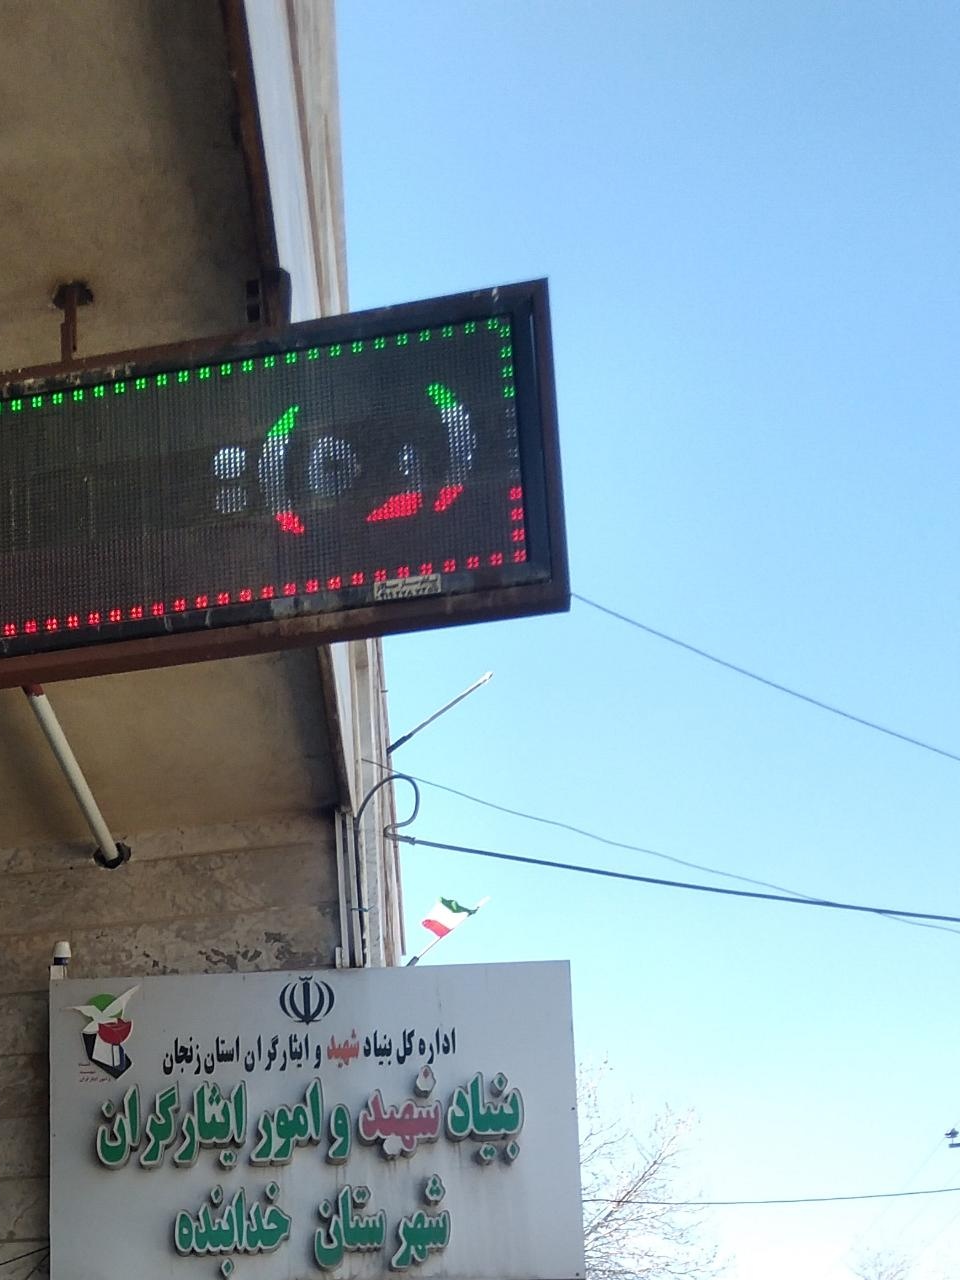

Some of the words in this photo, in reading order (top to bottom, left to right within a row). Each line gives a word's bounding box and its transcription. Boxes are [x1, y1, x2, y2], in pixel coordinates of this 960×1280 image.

[162, 1036, 201, 1075] زنجان
[203, 1036, 240, 1075] استان
[313, 1043, 322, 1069] و
[326, 1028, 360, 1068] شهید
[363, 1029, 393, 1066] بنیاد
[396, 1028, 415, 1064] کل
[418, 1027, 456, 1065] اداره
[96, 1080, 247, 1169] ایثارگران
[250, 1077, 322, 1166] امور
[357, 1064, 442, 1161] شهید
[446, 1071, 525, 1165] بنیاد
[327, 1103, 352, 1165] و
[174, 1180, 292, 1280] خدابنده
